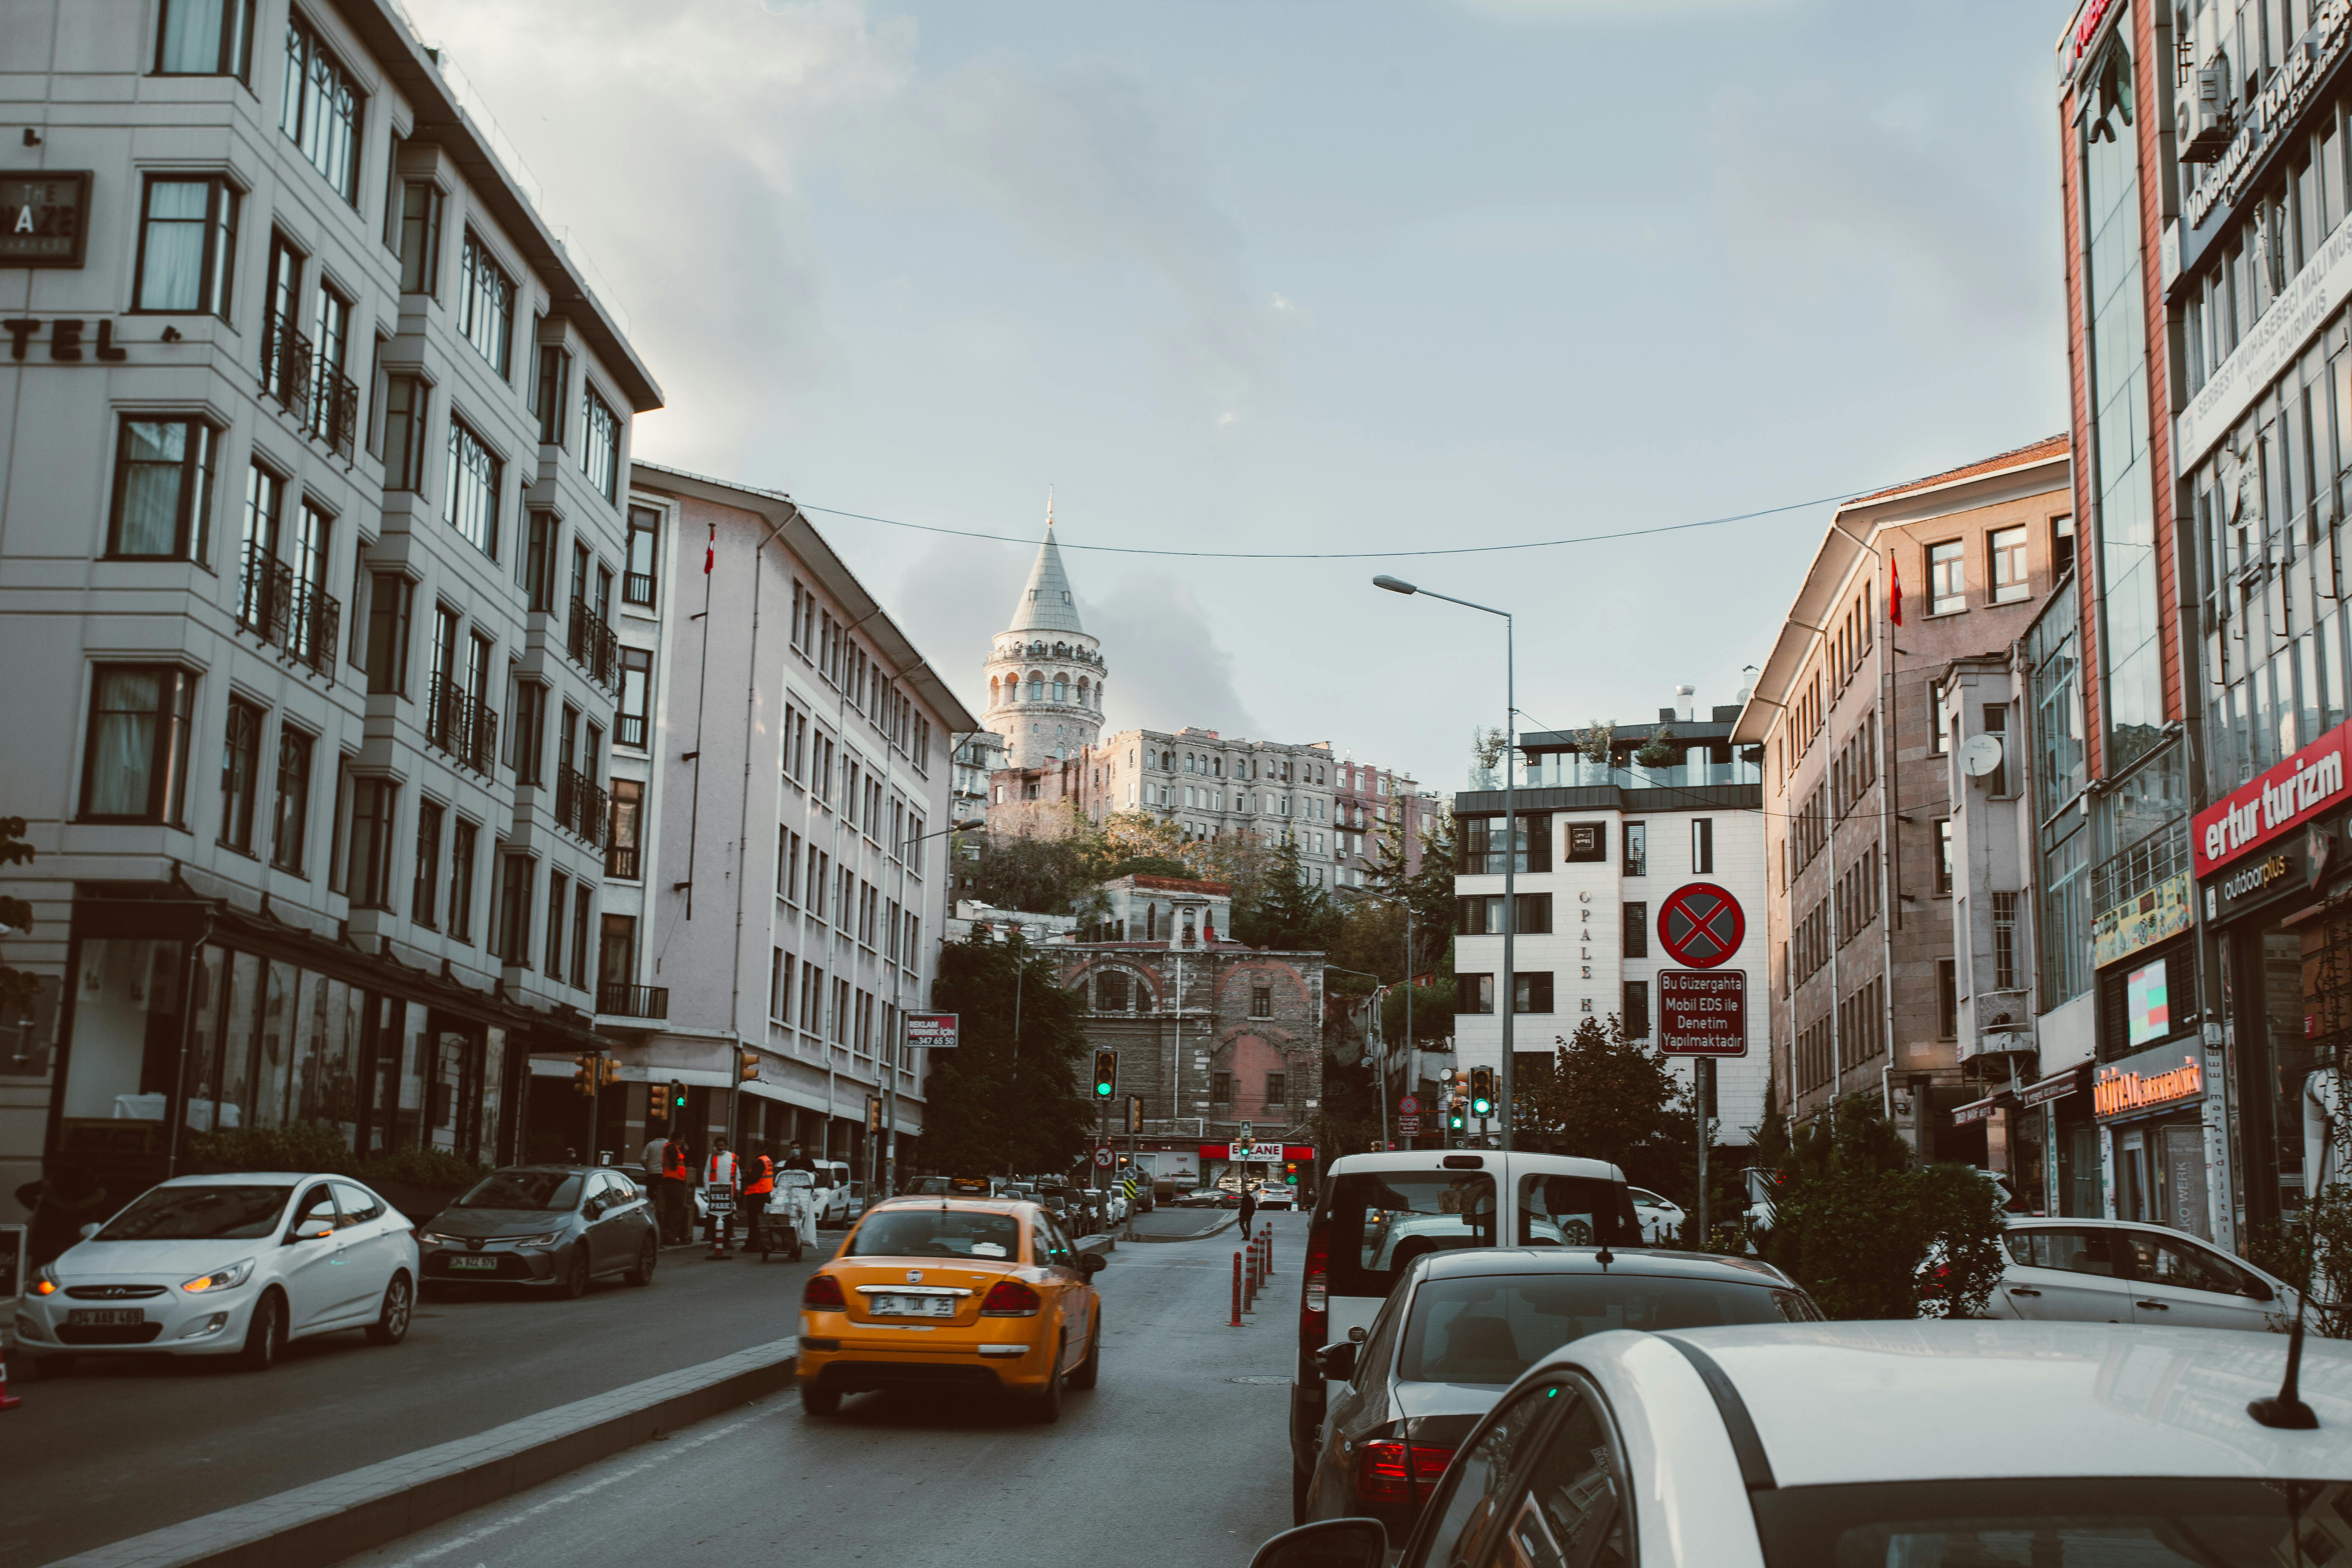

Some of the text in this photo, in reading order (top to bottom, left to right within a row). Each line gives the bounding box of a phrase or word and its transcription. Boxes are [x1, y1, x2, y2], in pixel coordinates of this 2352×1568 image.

[2187, 127, 2250, 230] VANGUARD
[2255, 43, 2310, 134] TRAVEL
[2197, 363, 2235, 421] SERBEST
[2205, 750, 2344, 861] ertur turizm
[2224, 855, 2285, 900] outdoorplus
[1663, 975, 1742, 993] Bu Güzergahta
[1666, 998, 1738, 1011] Mobil EDS ile
[1677, 1015, 1728, 1029] Denetim
[933, 1037, 944, 1045] 65
[1663, 1033, 1743, 1050] Yapılmaktadır
[1232, 1145, 1280, 1155] EZANE
